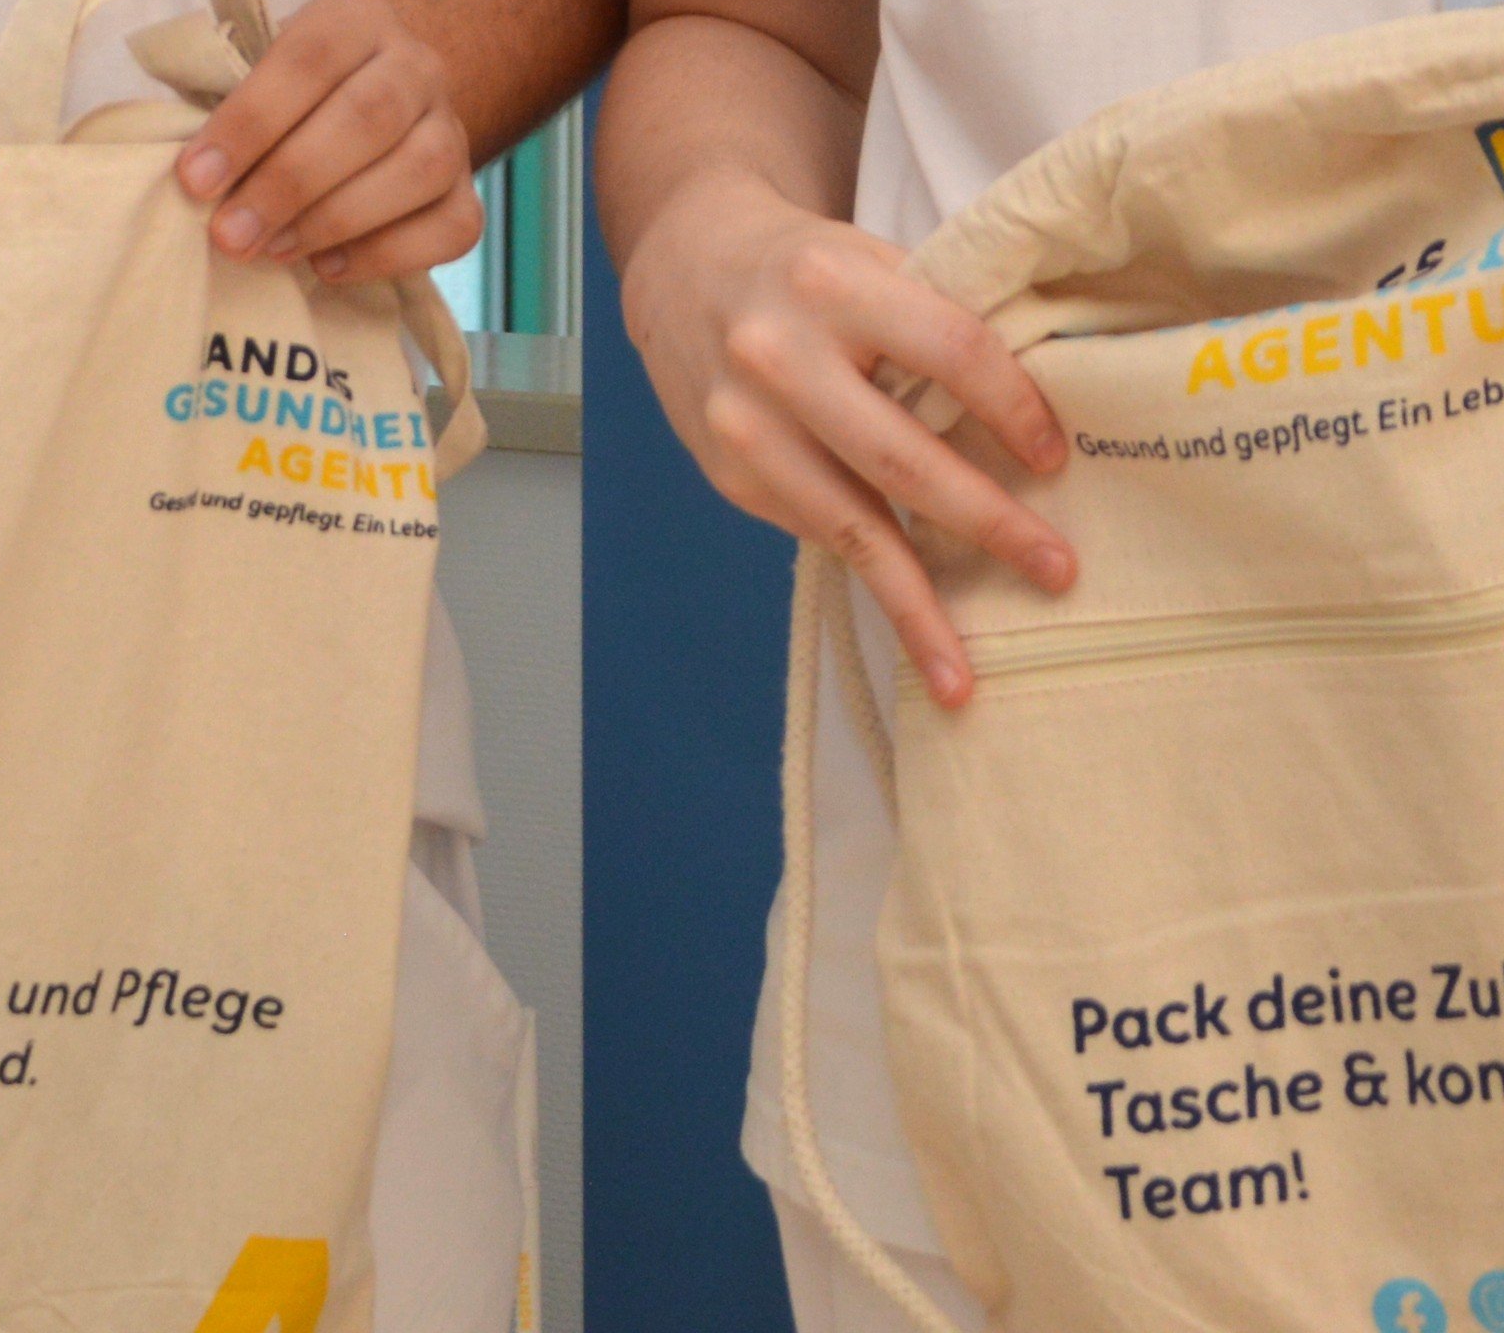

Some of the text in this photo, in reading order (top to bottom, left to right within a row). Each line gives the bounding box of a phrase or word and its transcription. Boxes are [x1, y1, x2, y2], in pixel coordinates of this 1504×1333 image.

[1076, 429, 1170, 463] Gesund
[1177, 426, 1228, 460] und
[1235, 409, 1370, 461] gepflegt.
[1378, 398, 1434, 433] Ein
[200, 491, 245, 511] und
[352, 513, 385, 535] Ein
[7, 970, 102, 1017] und
[111, 967, 285, 1035] Pflege
[1072, 981, 1232, 1055] Pack
[1246, 967, 1418, 1039] deine
[1086, 1063, 1324, 1139] Tasche
[1342, 1049, 1390, 1111] &
[1104, 1149, 1312, 1223] Team!
